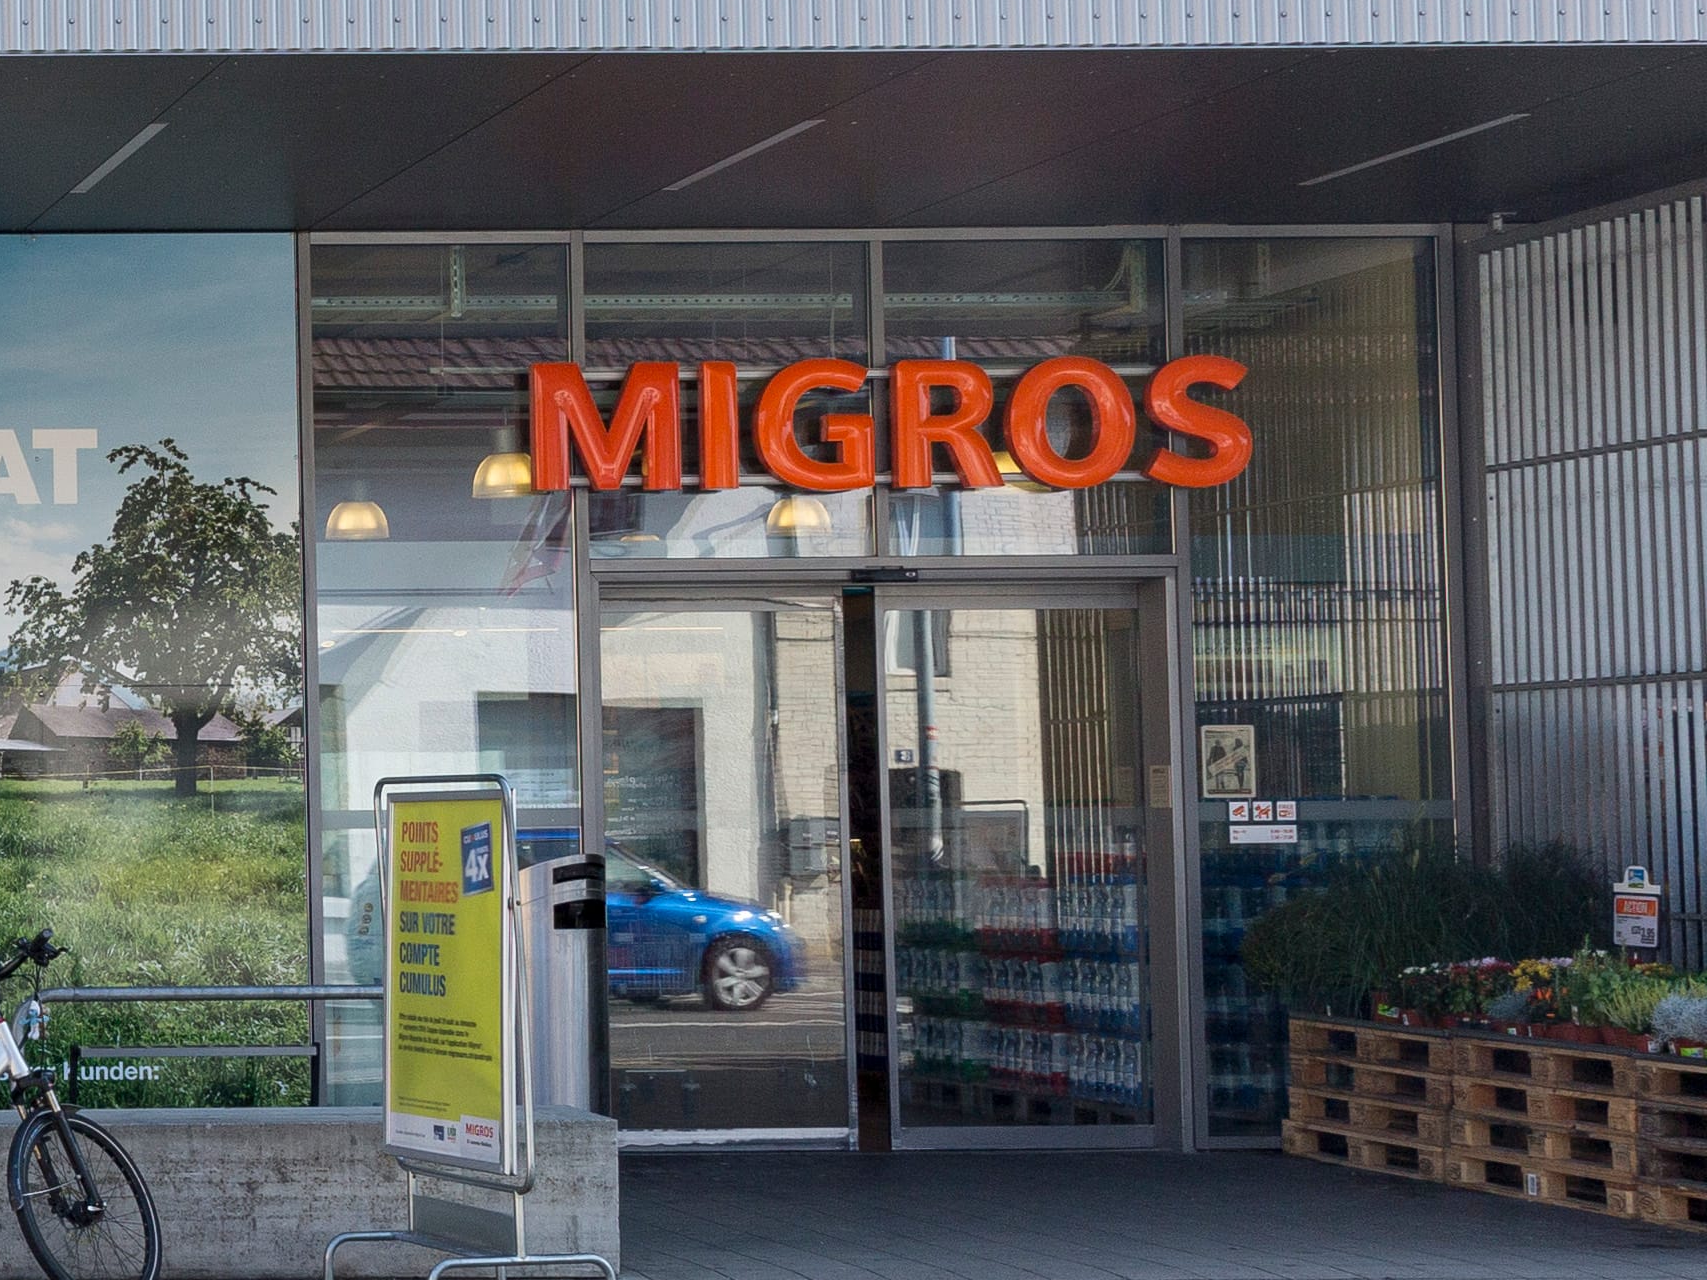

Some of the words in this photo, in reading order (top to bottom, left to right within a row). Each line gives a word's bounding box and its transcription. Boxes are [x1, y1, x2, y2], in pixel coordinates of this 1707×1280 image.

[530, 355, 1253, 490] MIGROS
[401, 821, 439, 844] POINTS
[400, 847, 444, 873] SUPPLÉ-
[399, 880, 459, 904] MENTAIRES
[399, 910, 419, 934] SUR
[421, 911, 456, 936] VOTRE
[399, 942, 440, 967] COMPTE
[399, 971, 446, 997] CUMULUS
[465, 1122, 494, 1139] MIGROS
